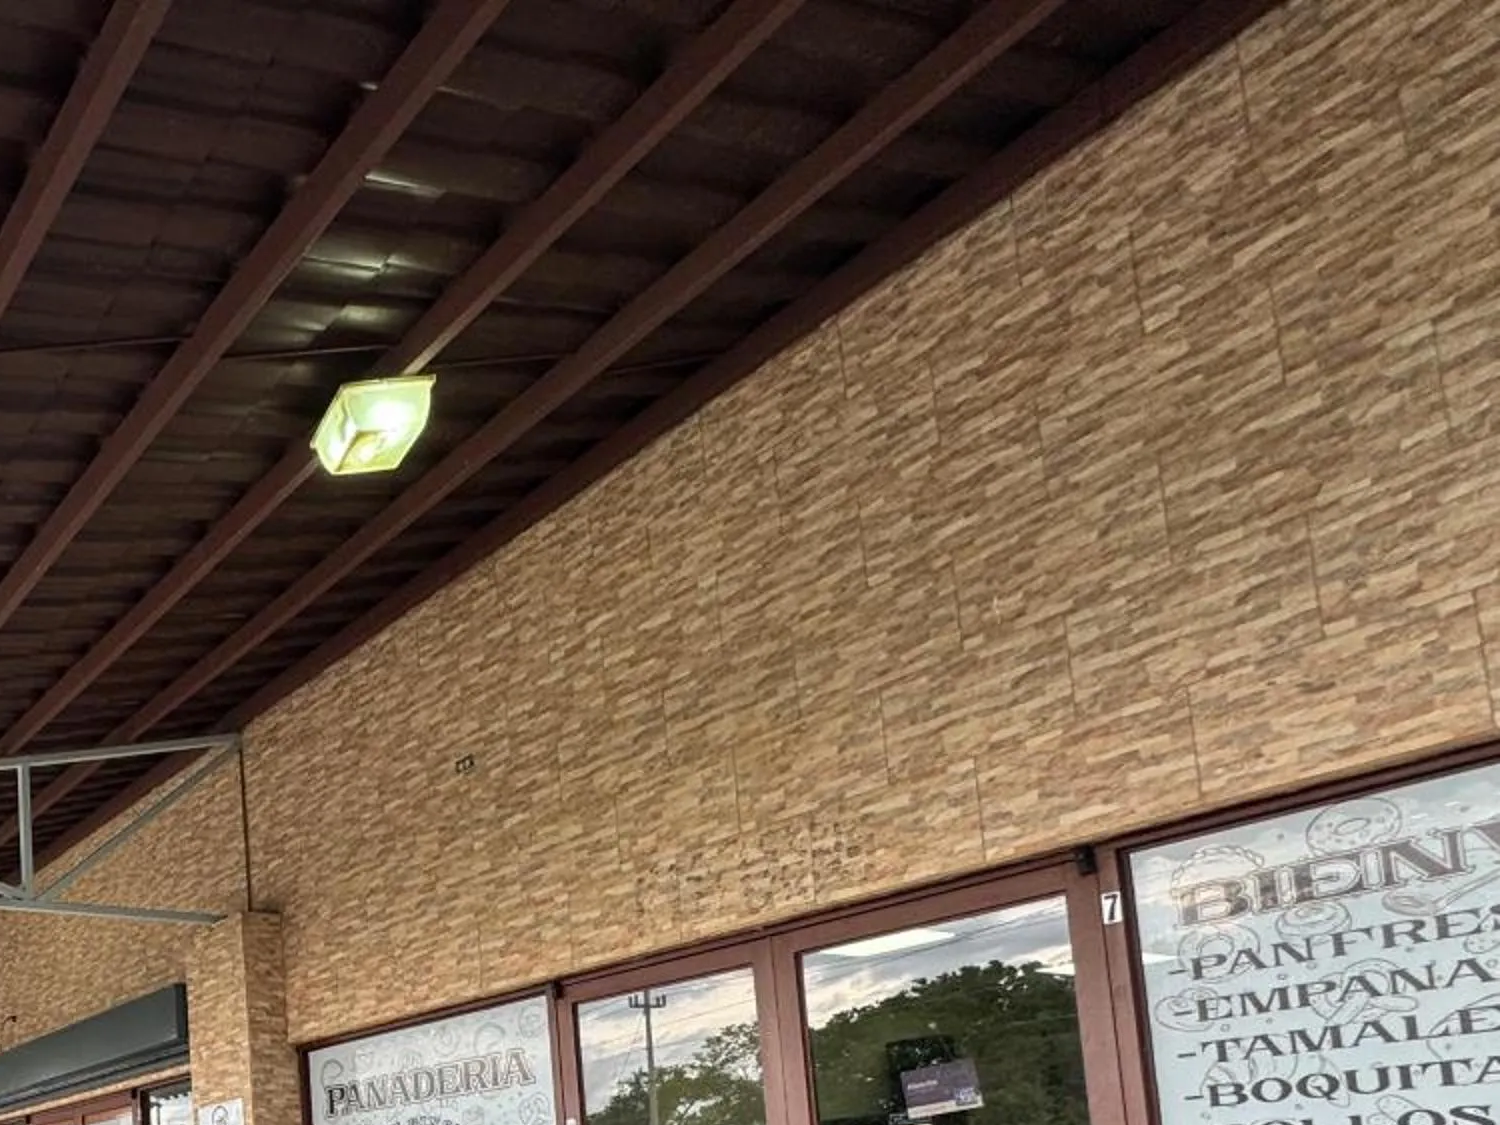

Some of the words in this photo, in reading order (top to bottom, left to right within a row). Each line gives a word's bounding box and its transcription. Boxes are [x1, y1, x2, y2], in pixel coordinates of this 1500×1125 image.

[1104, 894, 1118, 921] 7
[1331, 904, 1500, 957] FRE
[324, 1047, 536, 1117] PANADERIA
